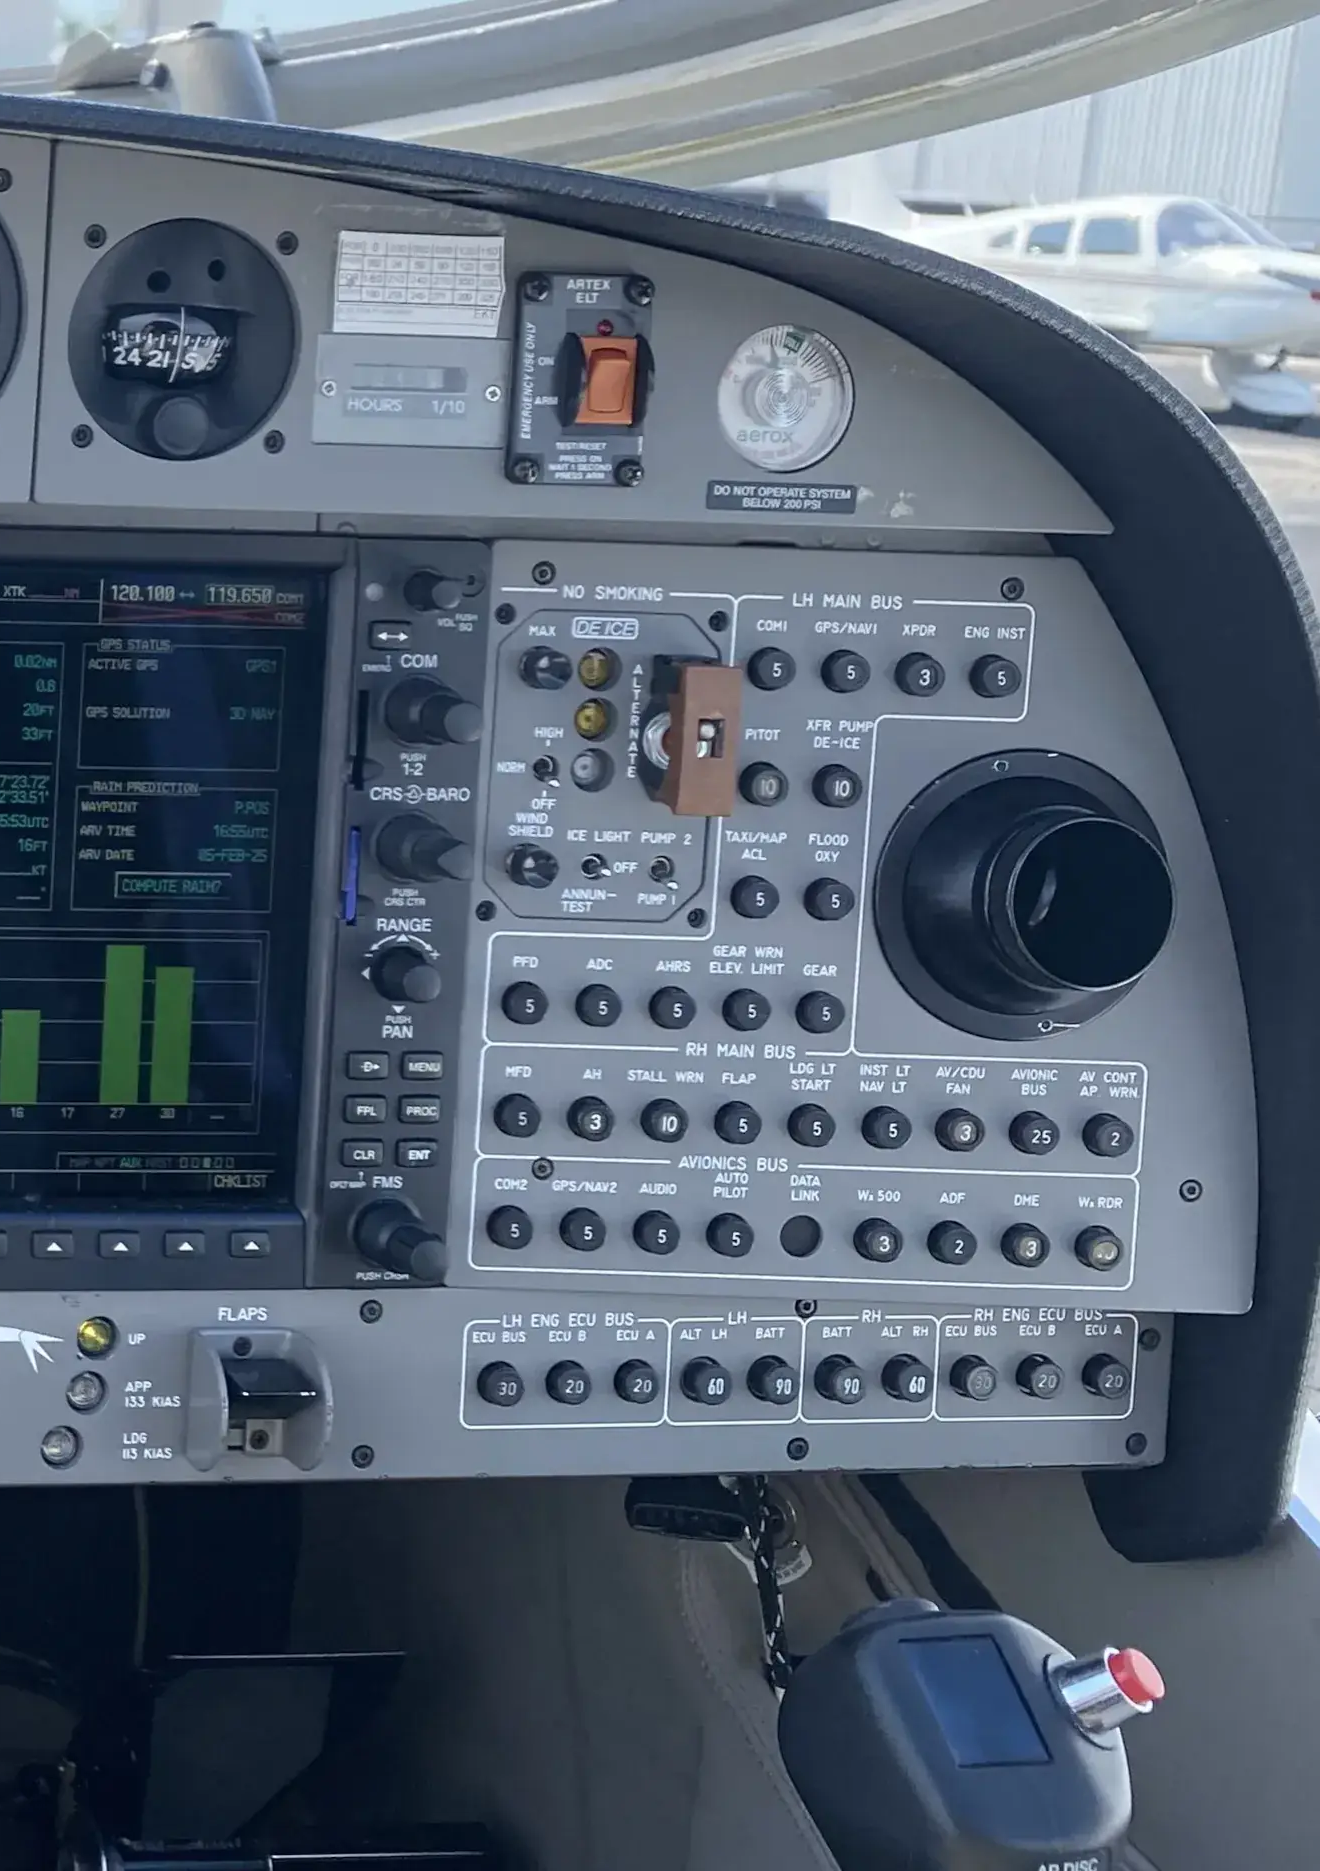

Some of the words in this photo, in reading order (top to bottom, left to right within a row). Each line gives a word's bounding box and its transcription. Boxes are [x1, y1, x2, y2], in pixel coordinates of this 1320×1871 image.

[567, 279, 610, 290] ARTEX
[576, 292, 599, 303] ELT
[347, 399, 402, 411] HOURS
[432, 400, 465, 414] 1/10
[737, 428, 793, 443] aerox
[714, 485, 730, 495] DO
[734, 485, 755, 496] NOT
[758, 487, 807, 498] OPERATE
[809, 488, 851, 499] SYSTEM
[742, 497, 781, 509] BELOW
[784, 498, 802, 509] 200
[804, 499, 821, 509] PSI
[111, 585, 176, 601] 120.100
[209, 588, 272, 604] 119.650
[563, 586, 584, 598] NO
[595, 587, 663, 600] SMOKING
[793, 594, 813, 607] LH
[822, 595, 861, 608] MAIN
[871, 596, 902, 609] BUS
[965, 626, 990, 638] ENG
[997, 628, 1025, 639] INST
[745, 729, 780, 740] PITOT
[516, 813, 548, 824] WIND
[509, 825, 554, 837] SHIELD
[567, 831, 589, 841] ICE
[594, 831, 630, 843] LIGHT
[713, 945, 746, 958] GEAR
[755, 946, 783, 958] WRN
[513, 956, 538, 968] PFD
[686, 1042, 707, 1056] RH
[717, 1044, 755, 1058] MAIN
[764, 1045, 795, 1059] BUS
[678, 1156, 746, 1170] AVIONICS
[757, 1158, 788, 1171] BUS
[640, 1183, 677, 1195] AUDIO
[218, 1307, 268, 1321] FLAPS
[502, 1315, 521, 1327] LH
[531, 1314, 559, 1327] ENG
[569, 1313, 596, 1326] ECU
[605, 1313, 634, 1326] BUS
